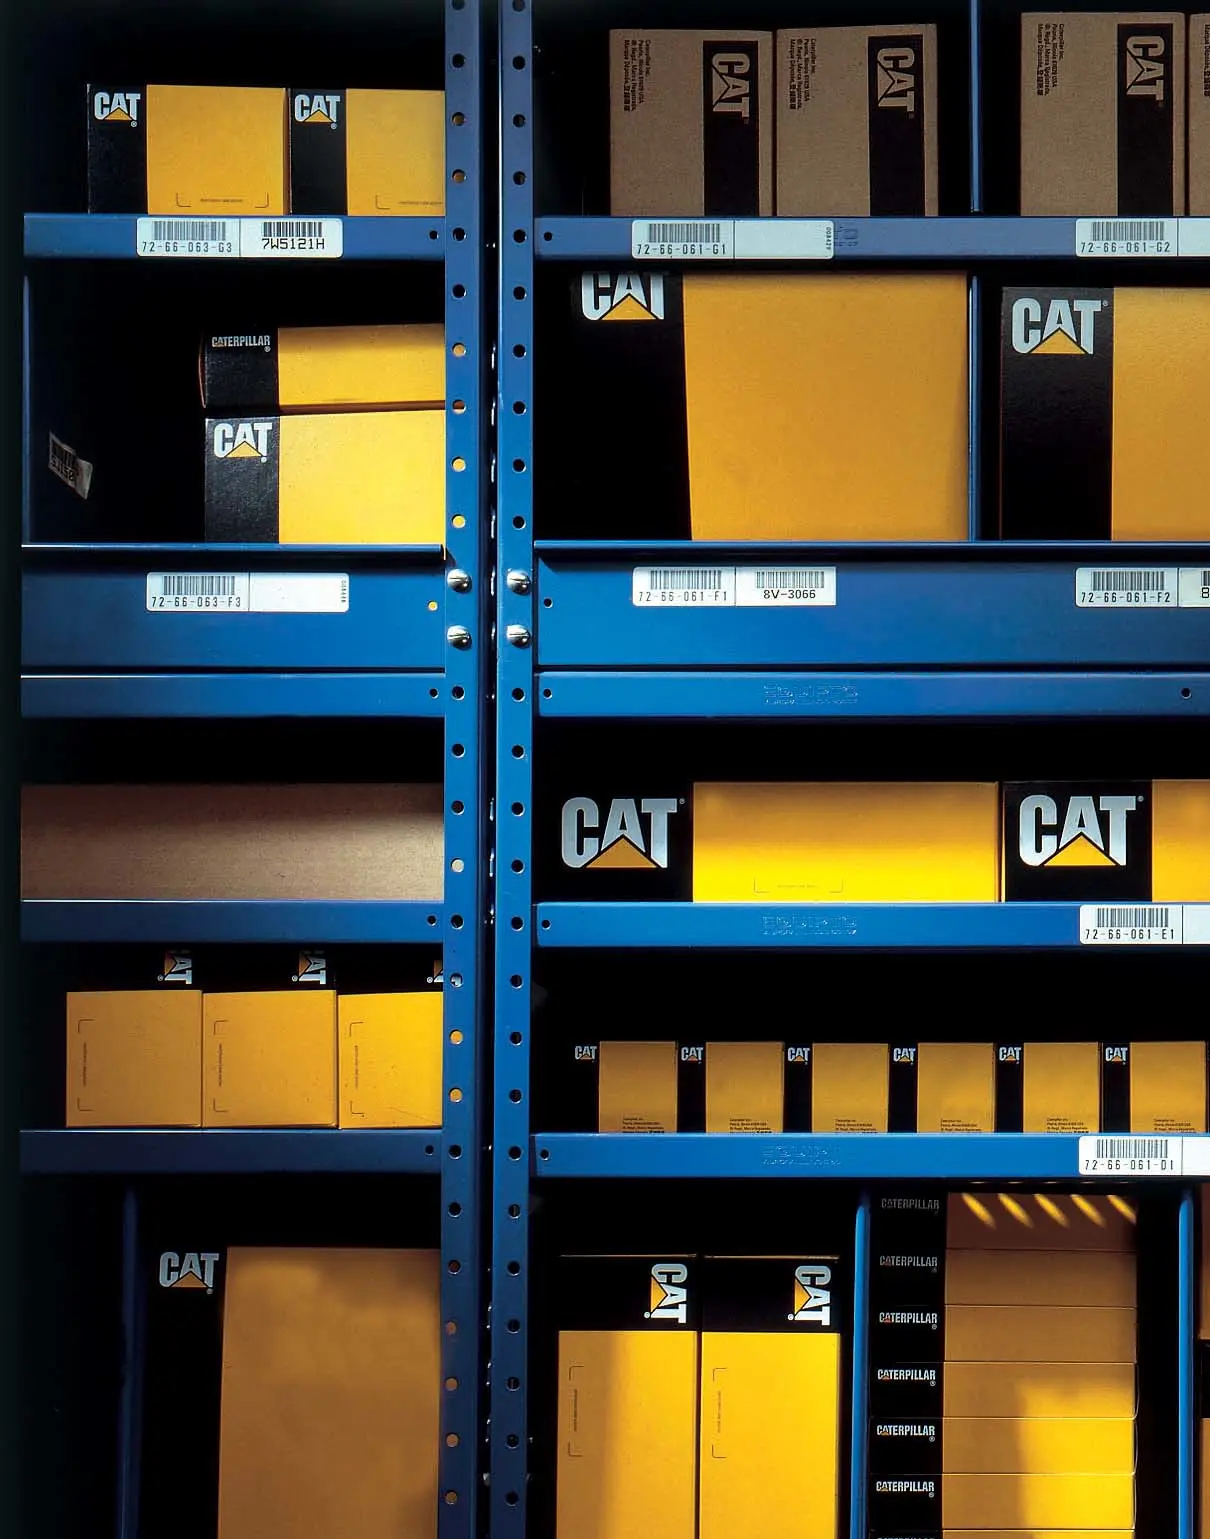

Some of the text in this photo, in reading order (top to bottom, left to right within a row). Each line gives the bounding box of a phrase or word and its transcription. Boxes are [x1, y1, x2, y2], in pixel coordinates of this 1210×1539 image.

[1124, 35, 1165, 100] CAT
[711, 51, 751, 118] CAT
[875, 47, 915, 113] CAT
[93, 92, 141, 121] CAT
[294, 93, 341, 123] CAT
[142, 240, 232, 252] 72-66-063-G3
[262, 237, 325, 249] 7W5121H
[637, 240, 726, 252] 72-66-061-G1
[1081, 240, 1170, 252] 72-66-061-G2
[581, 271, 665, 320] CAT
[1011, 297, 1102, 355] CAT
[211, 335, 271, 348] CATERPILLAR
[213, 422, 273, 458] CAT
[639, 590, 727, 601] 72-66-061-F1
[764, 589, 816, 599] 8V-3066
[1081, 591, 1170, 602] 72-66-061-F2
[152, 597, 241, 608] 72-66-063-F3
[560, 797, 679, 869] CAT
[1018, 795, 1136, 867] CAT
[1085, 928, 1174, 940] 72-66-061-E1
[574, 1046, 597, 1061] CAT
[680, 1047, 704, 1062] CAT
[787, 1047, 811, 1063] CAT
[893, 1048, 916, 1063] CAT
[998, 1047, 1021, 1062] CAT
[1105, 1047, 1128, 1062] CAT
[1085, 1159, 1174, 1170] 72-66-061-D1
[881, 1198, 939, 1210] CATERPILLAR
[879, 1255, 937, 1267] CATERPILLAR
[159, 1251, 219, 1288] CAT
[650, 1263, 688, 1324] CAT
[794, 1265, 831, 1326] CAT
[879, 1312, 937, 1324] CATERPILLAR
[877, 1368, 936, 1381] CATERPILLAR
[876, 1425, 935, 1437] CATERPILLAR
[876, 1480, 935, 1493] CATERPILLAR
